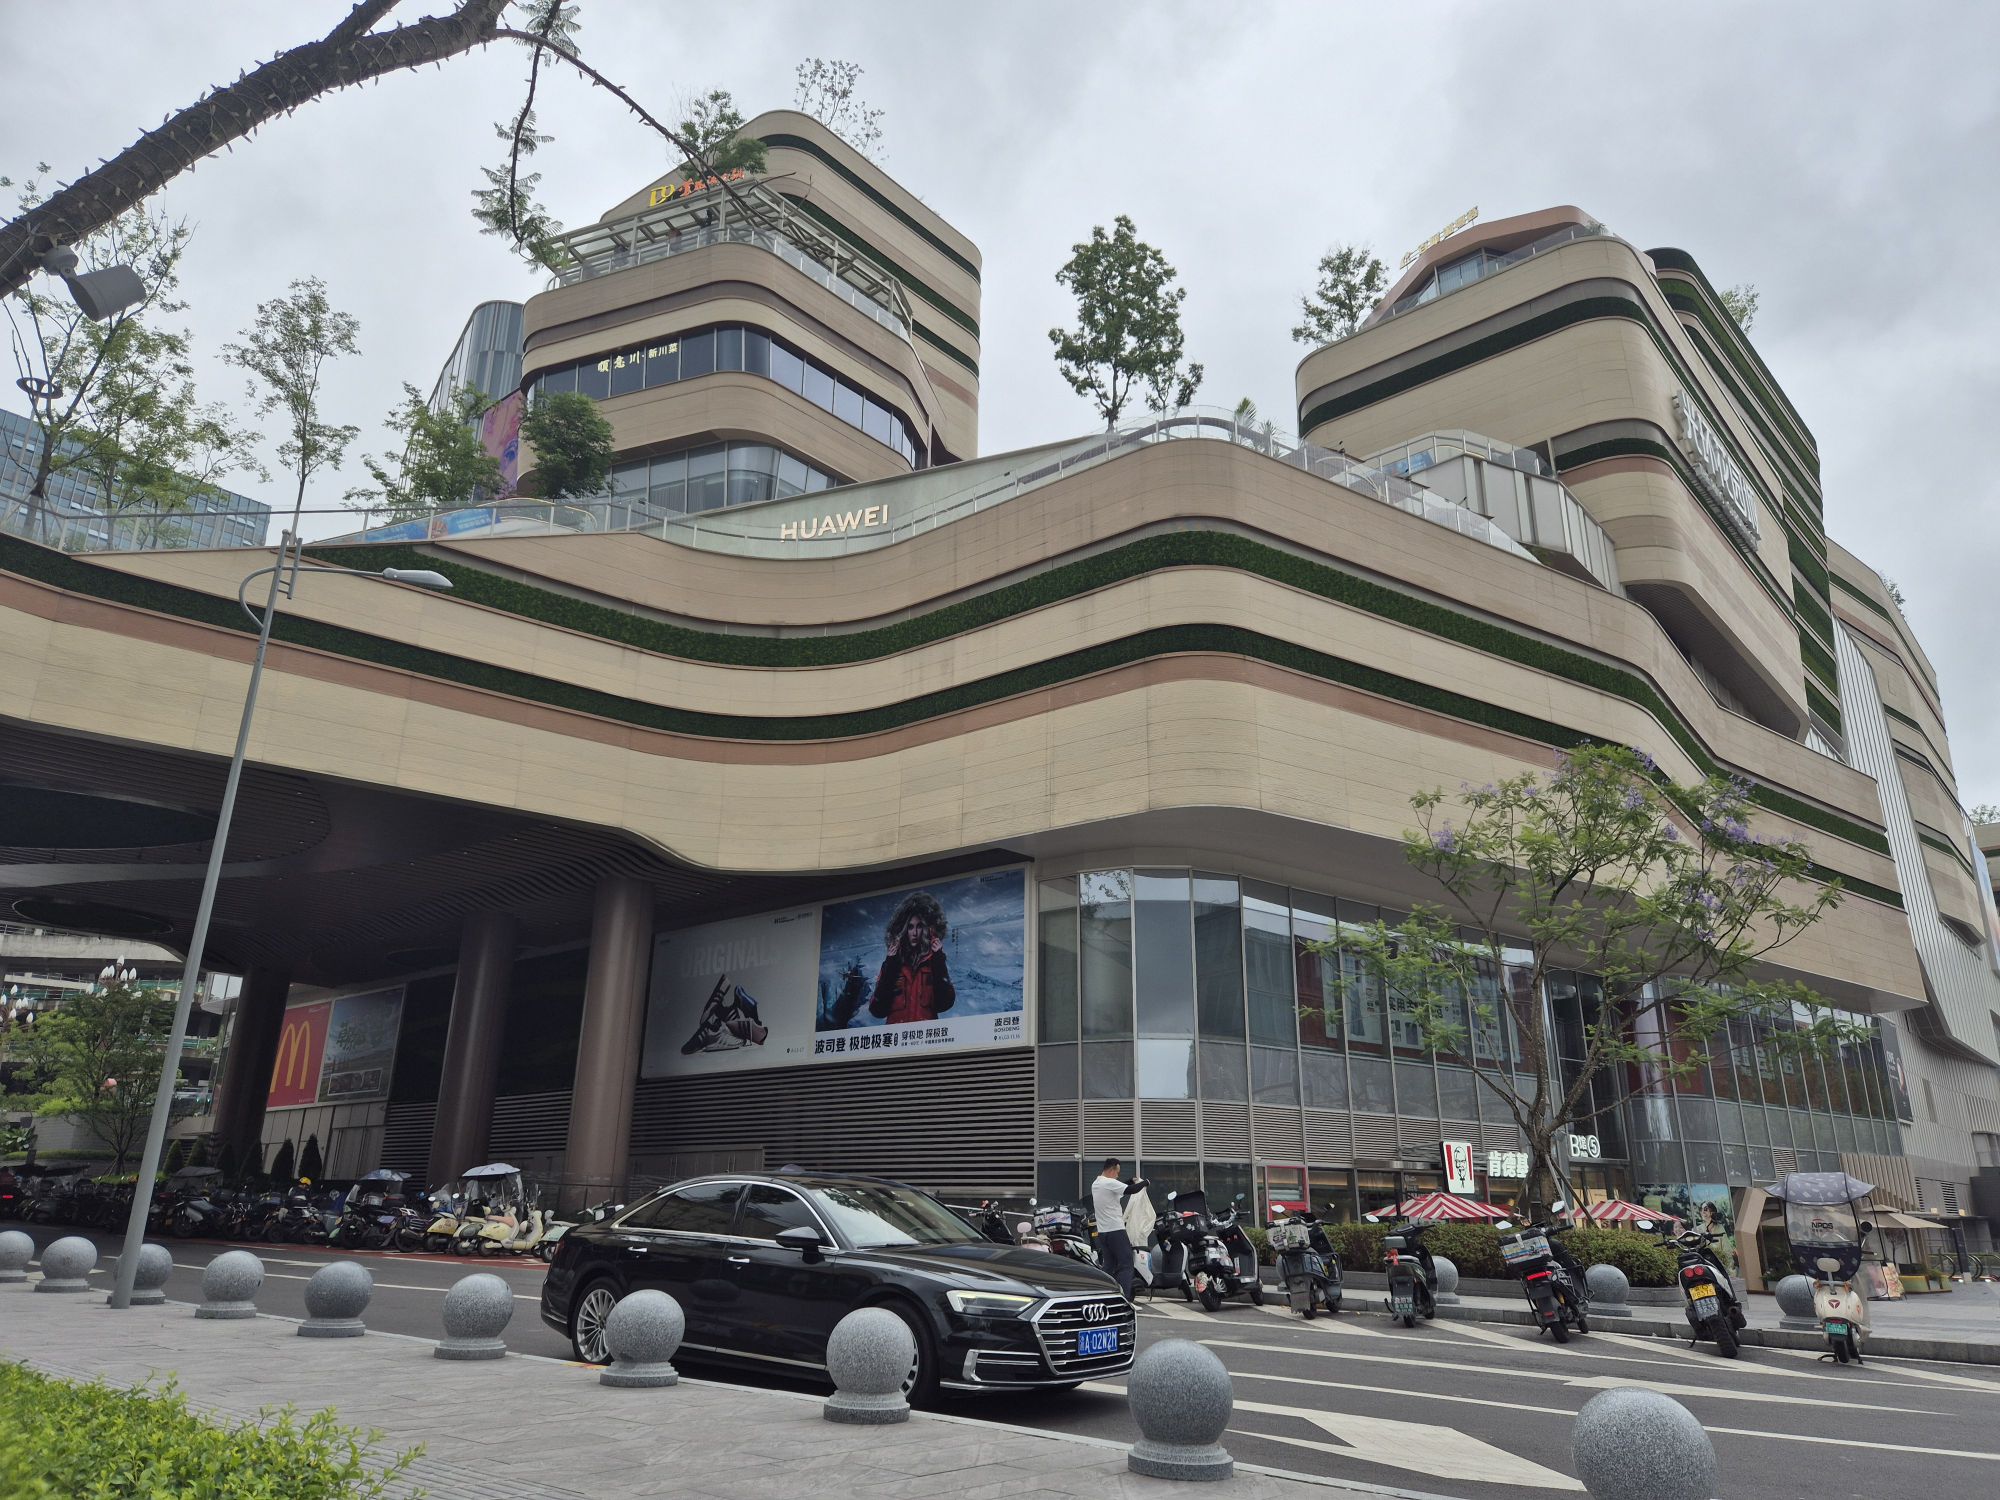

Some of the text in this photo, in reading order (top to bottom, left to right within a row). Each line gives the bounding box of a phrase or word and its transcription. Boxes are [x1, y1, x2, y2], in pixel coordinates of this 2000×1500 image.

[780, 504, 889, 540] HUAWEI
[814, 1037, 847, 1055] 波司登
[849, 1032, 893, 1052] 极地极寒
[1488, 1151, 1529, 1178] 肯德基
